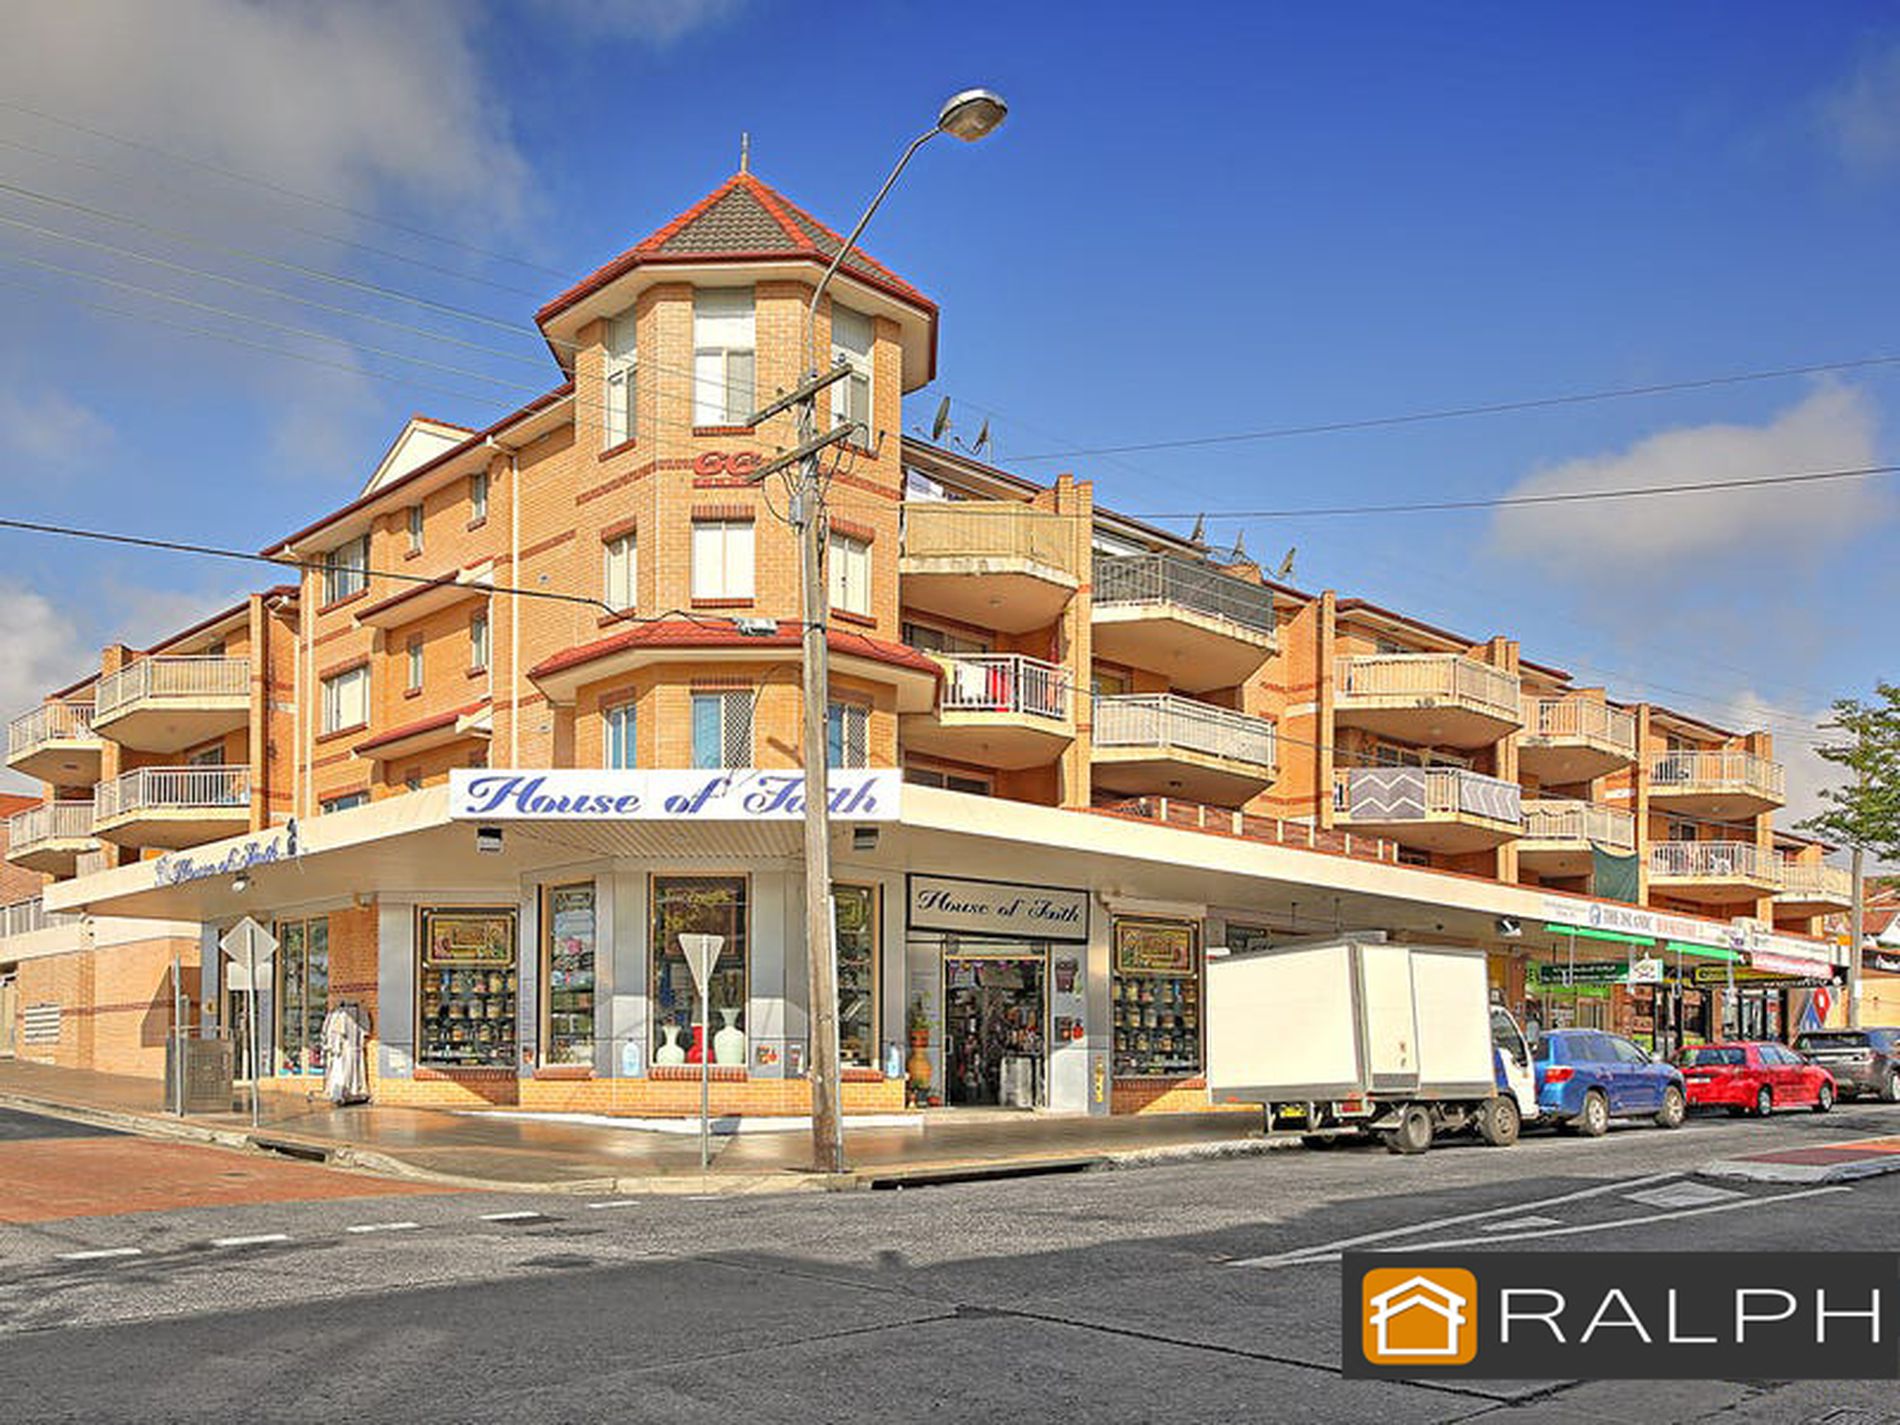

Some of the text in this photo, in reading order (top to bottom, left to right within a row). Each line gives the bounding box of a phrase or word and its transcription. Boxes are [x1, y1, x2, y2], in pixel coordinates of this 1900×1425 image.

[466, 776, 878, 815] House of Fath
[918, 890, 1080, 922] House of Faith
